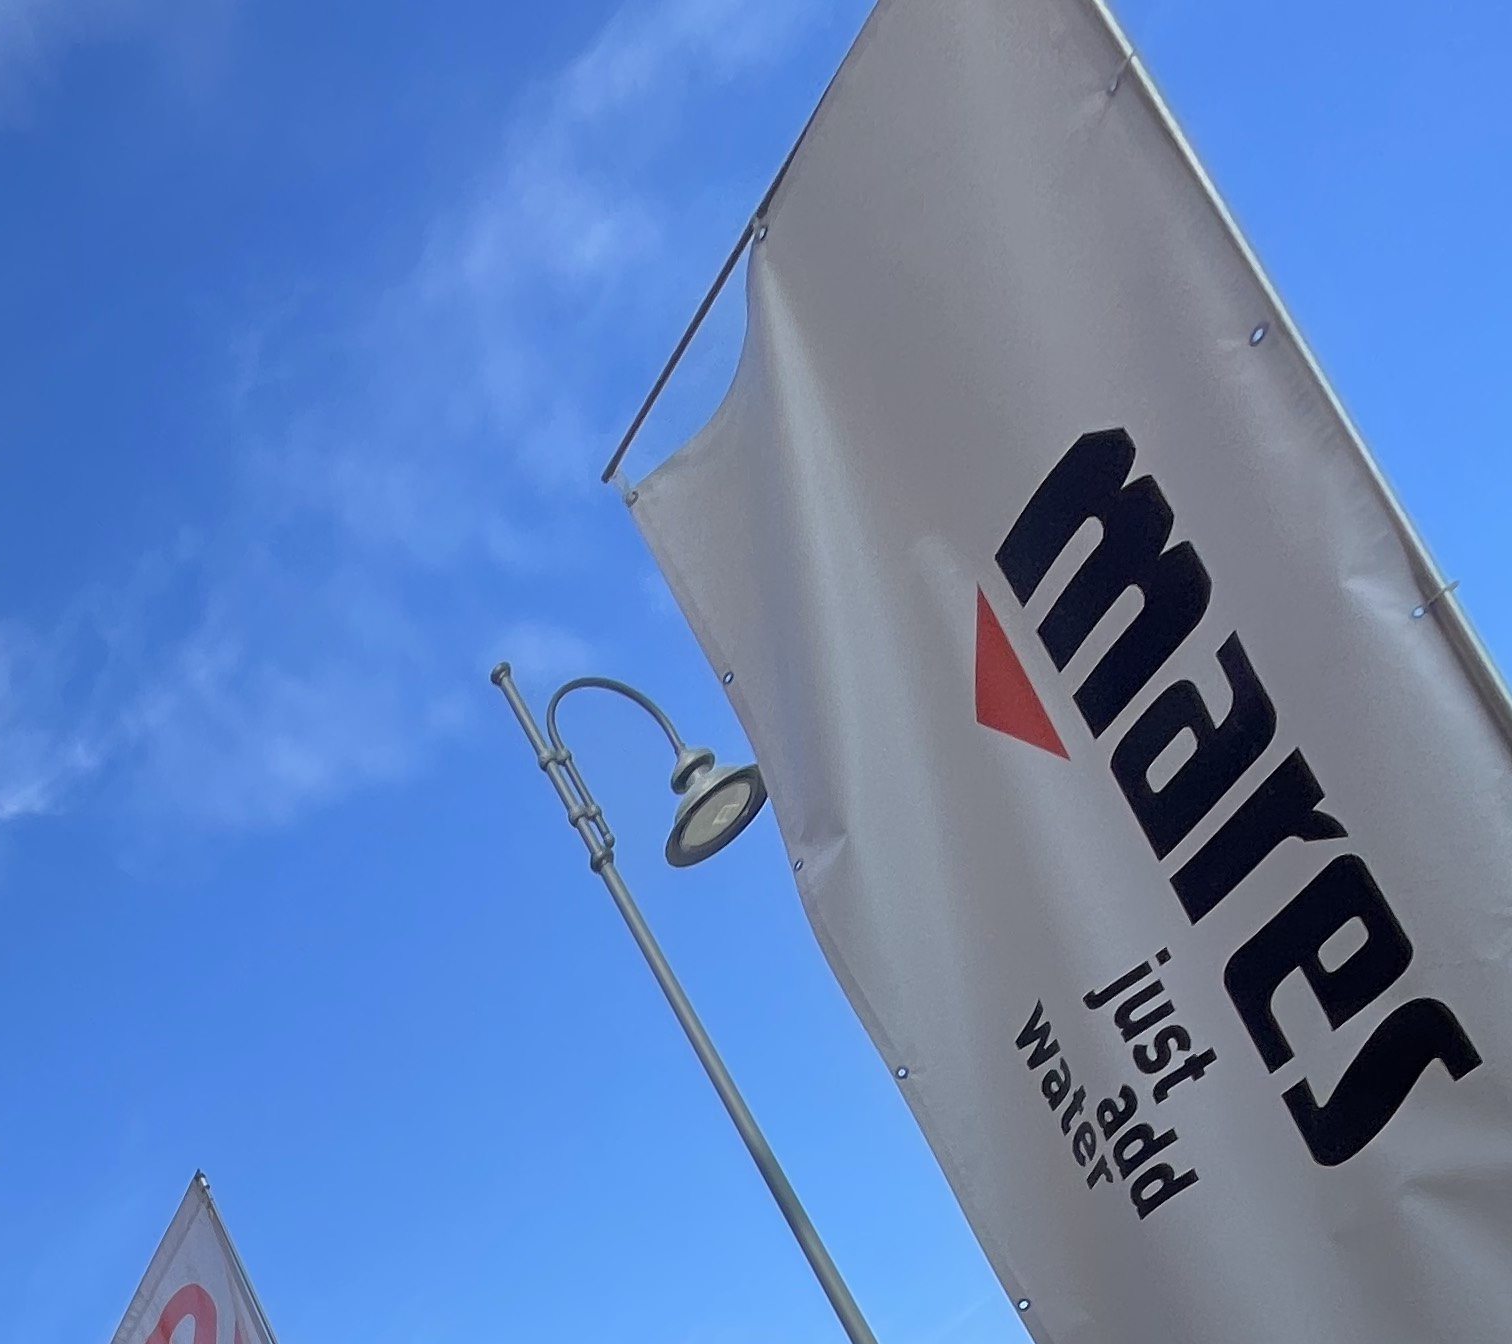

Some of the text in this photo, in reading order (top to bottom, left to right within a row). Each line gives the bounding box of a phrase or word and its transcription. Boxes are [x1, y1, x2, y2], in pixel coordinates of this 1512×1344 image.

[995, 427, 1483, 1167] mares
[1015, 999, 1113, 1190] water
[1083, 947, 1217, 1220] just add
